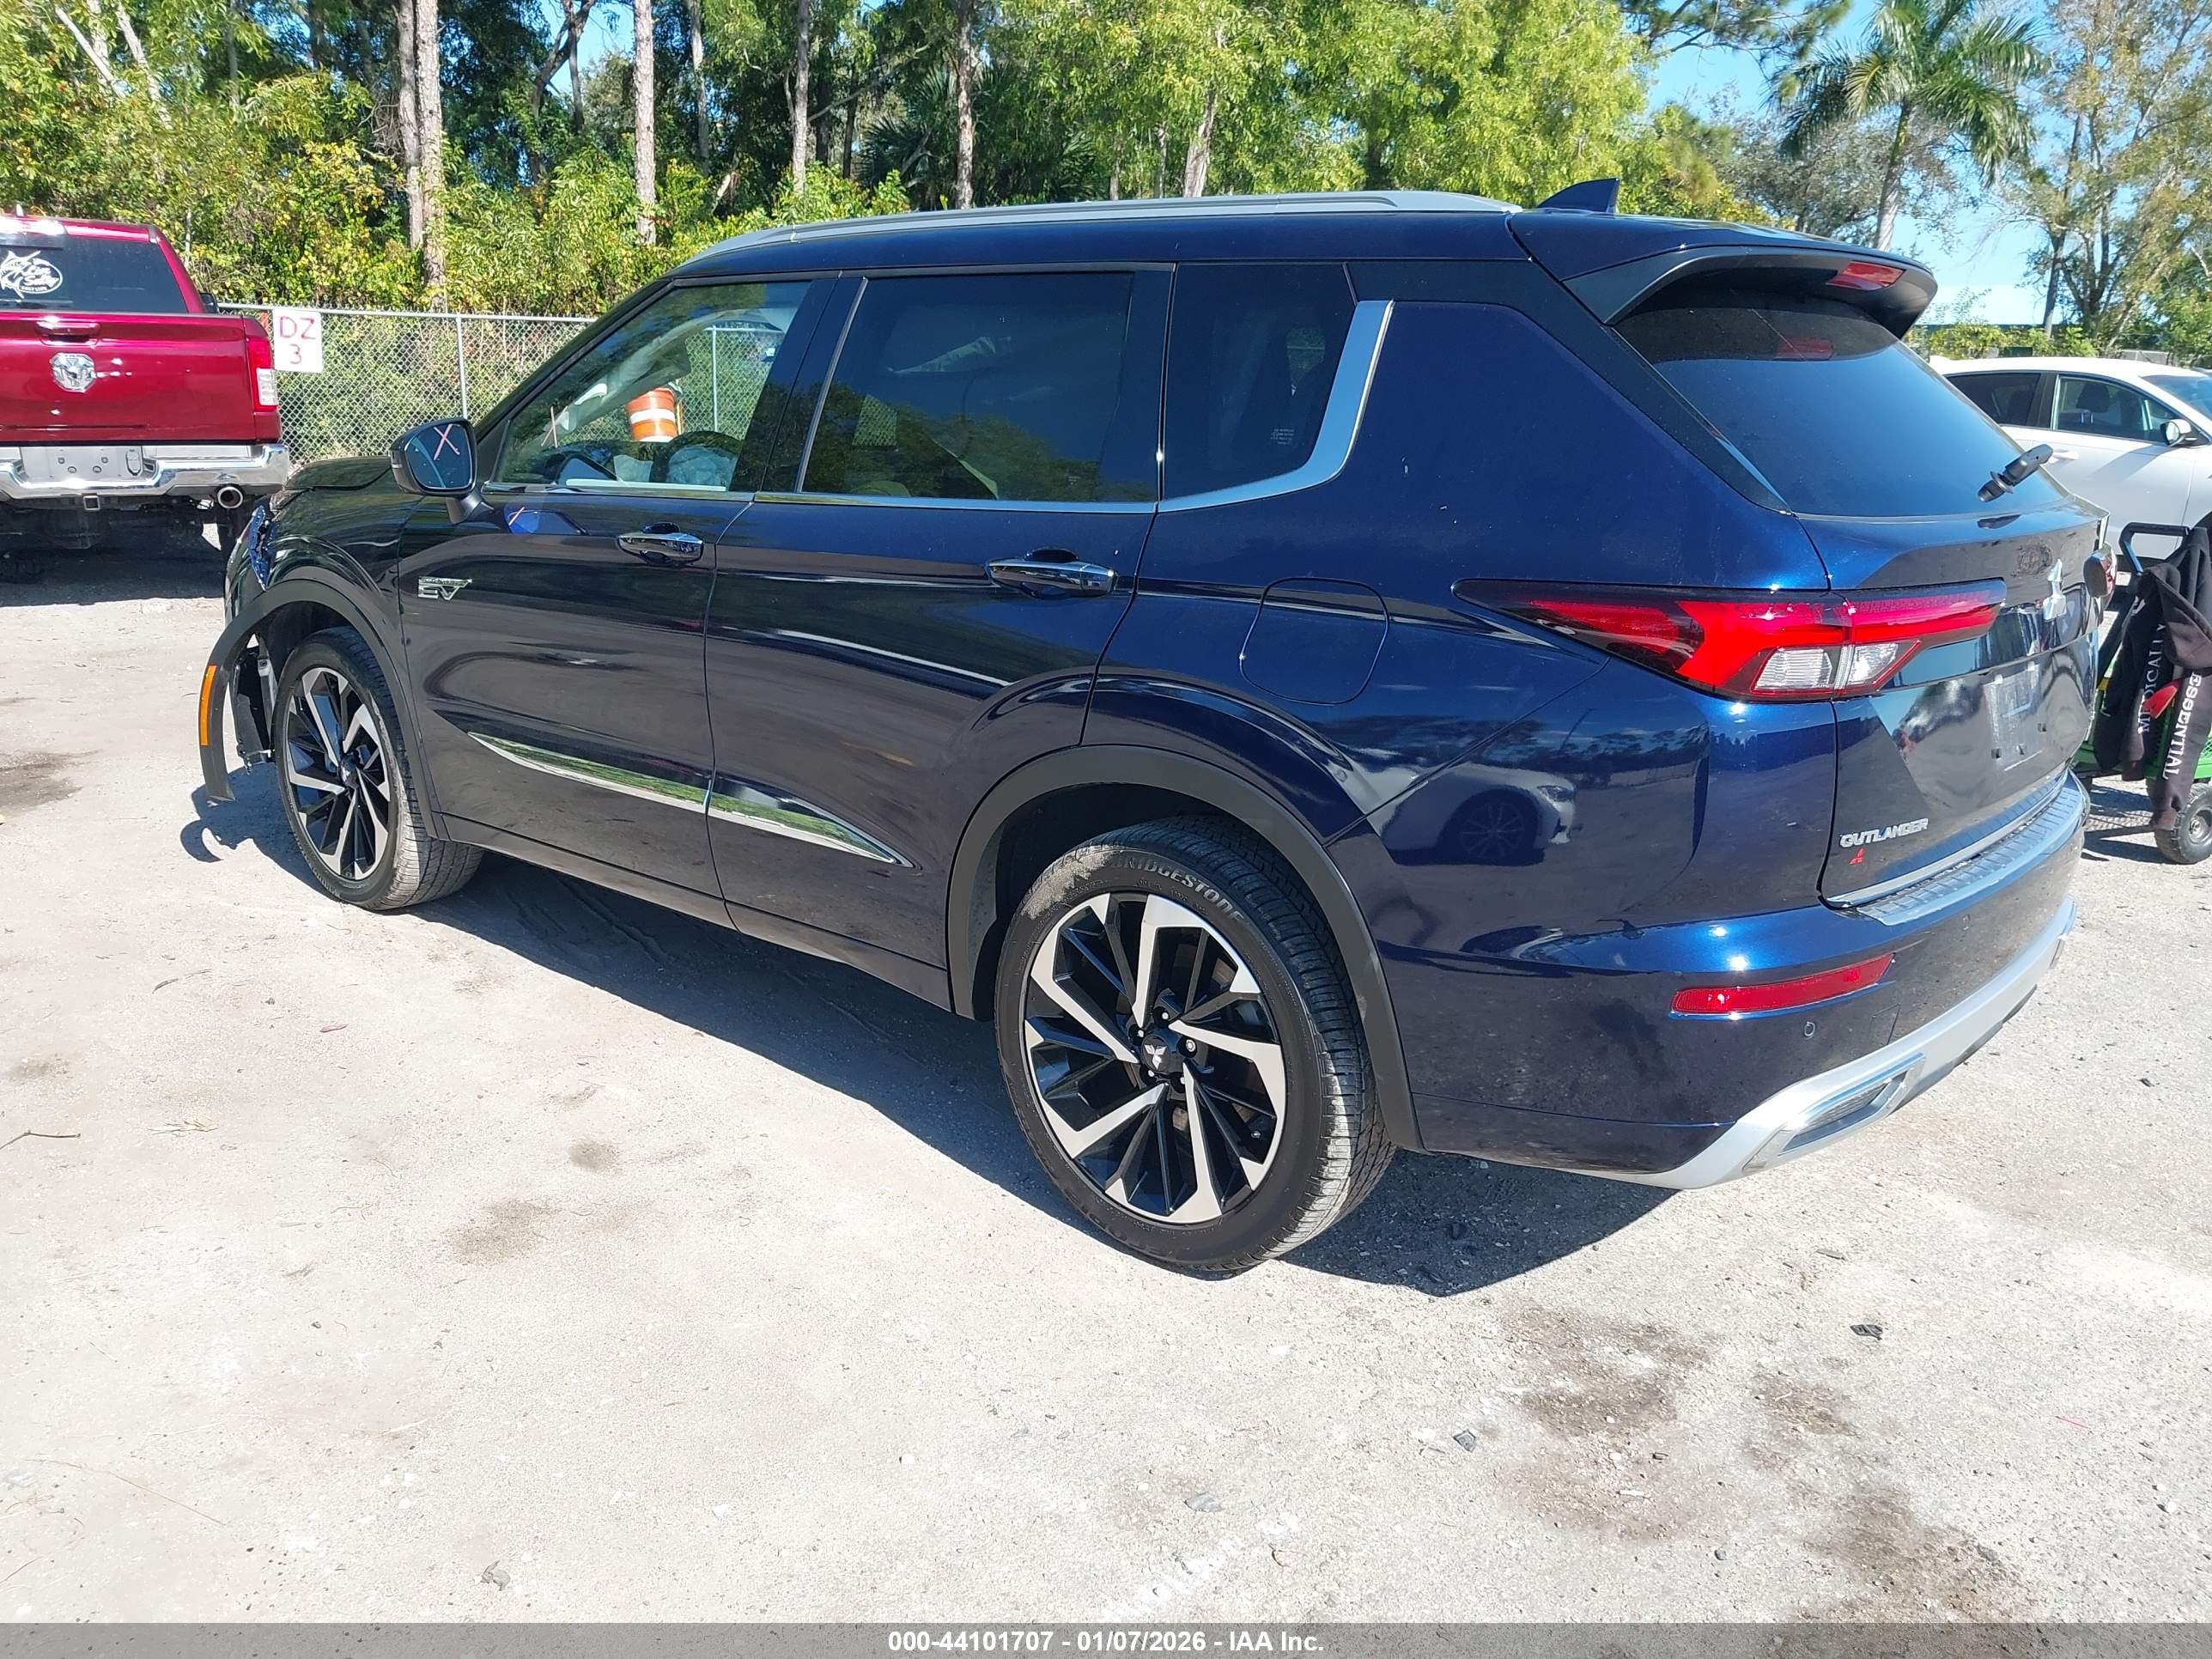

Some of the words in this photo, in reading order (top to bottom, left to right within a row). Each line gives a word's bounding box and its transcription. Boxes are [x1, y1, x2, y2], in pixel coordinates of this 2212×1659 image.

[279, 315, 317, 340] DZ
[289, 343, 302, 365] 3
[417, 583, 461, 601] EV
[2162, 672, 2202, 781] ESSENTIAL
[1839, 817, 1929, 848] OUTLANDER
